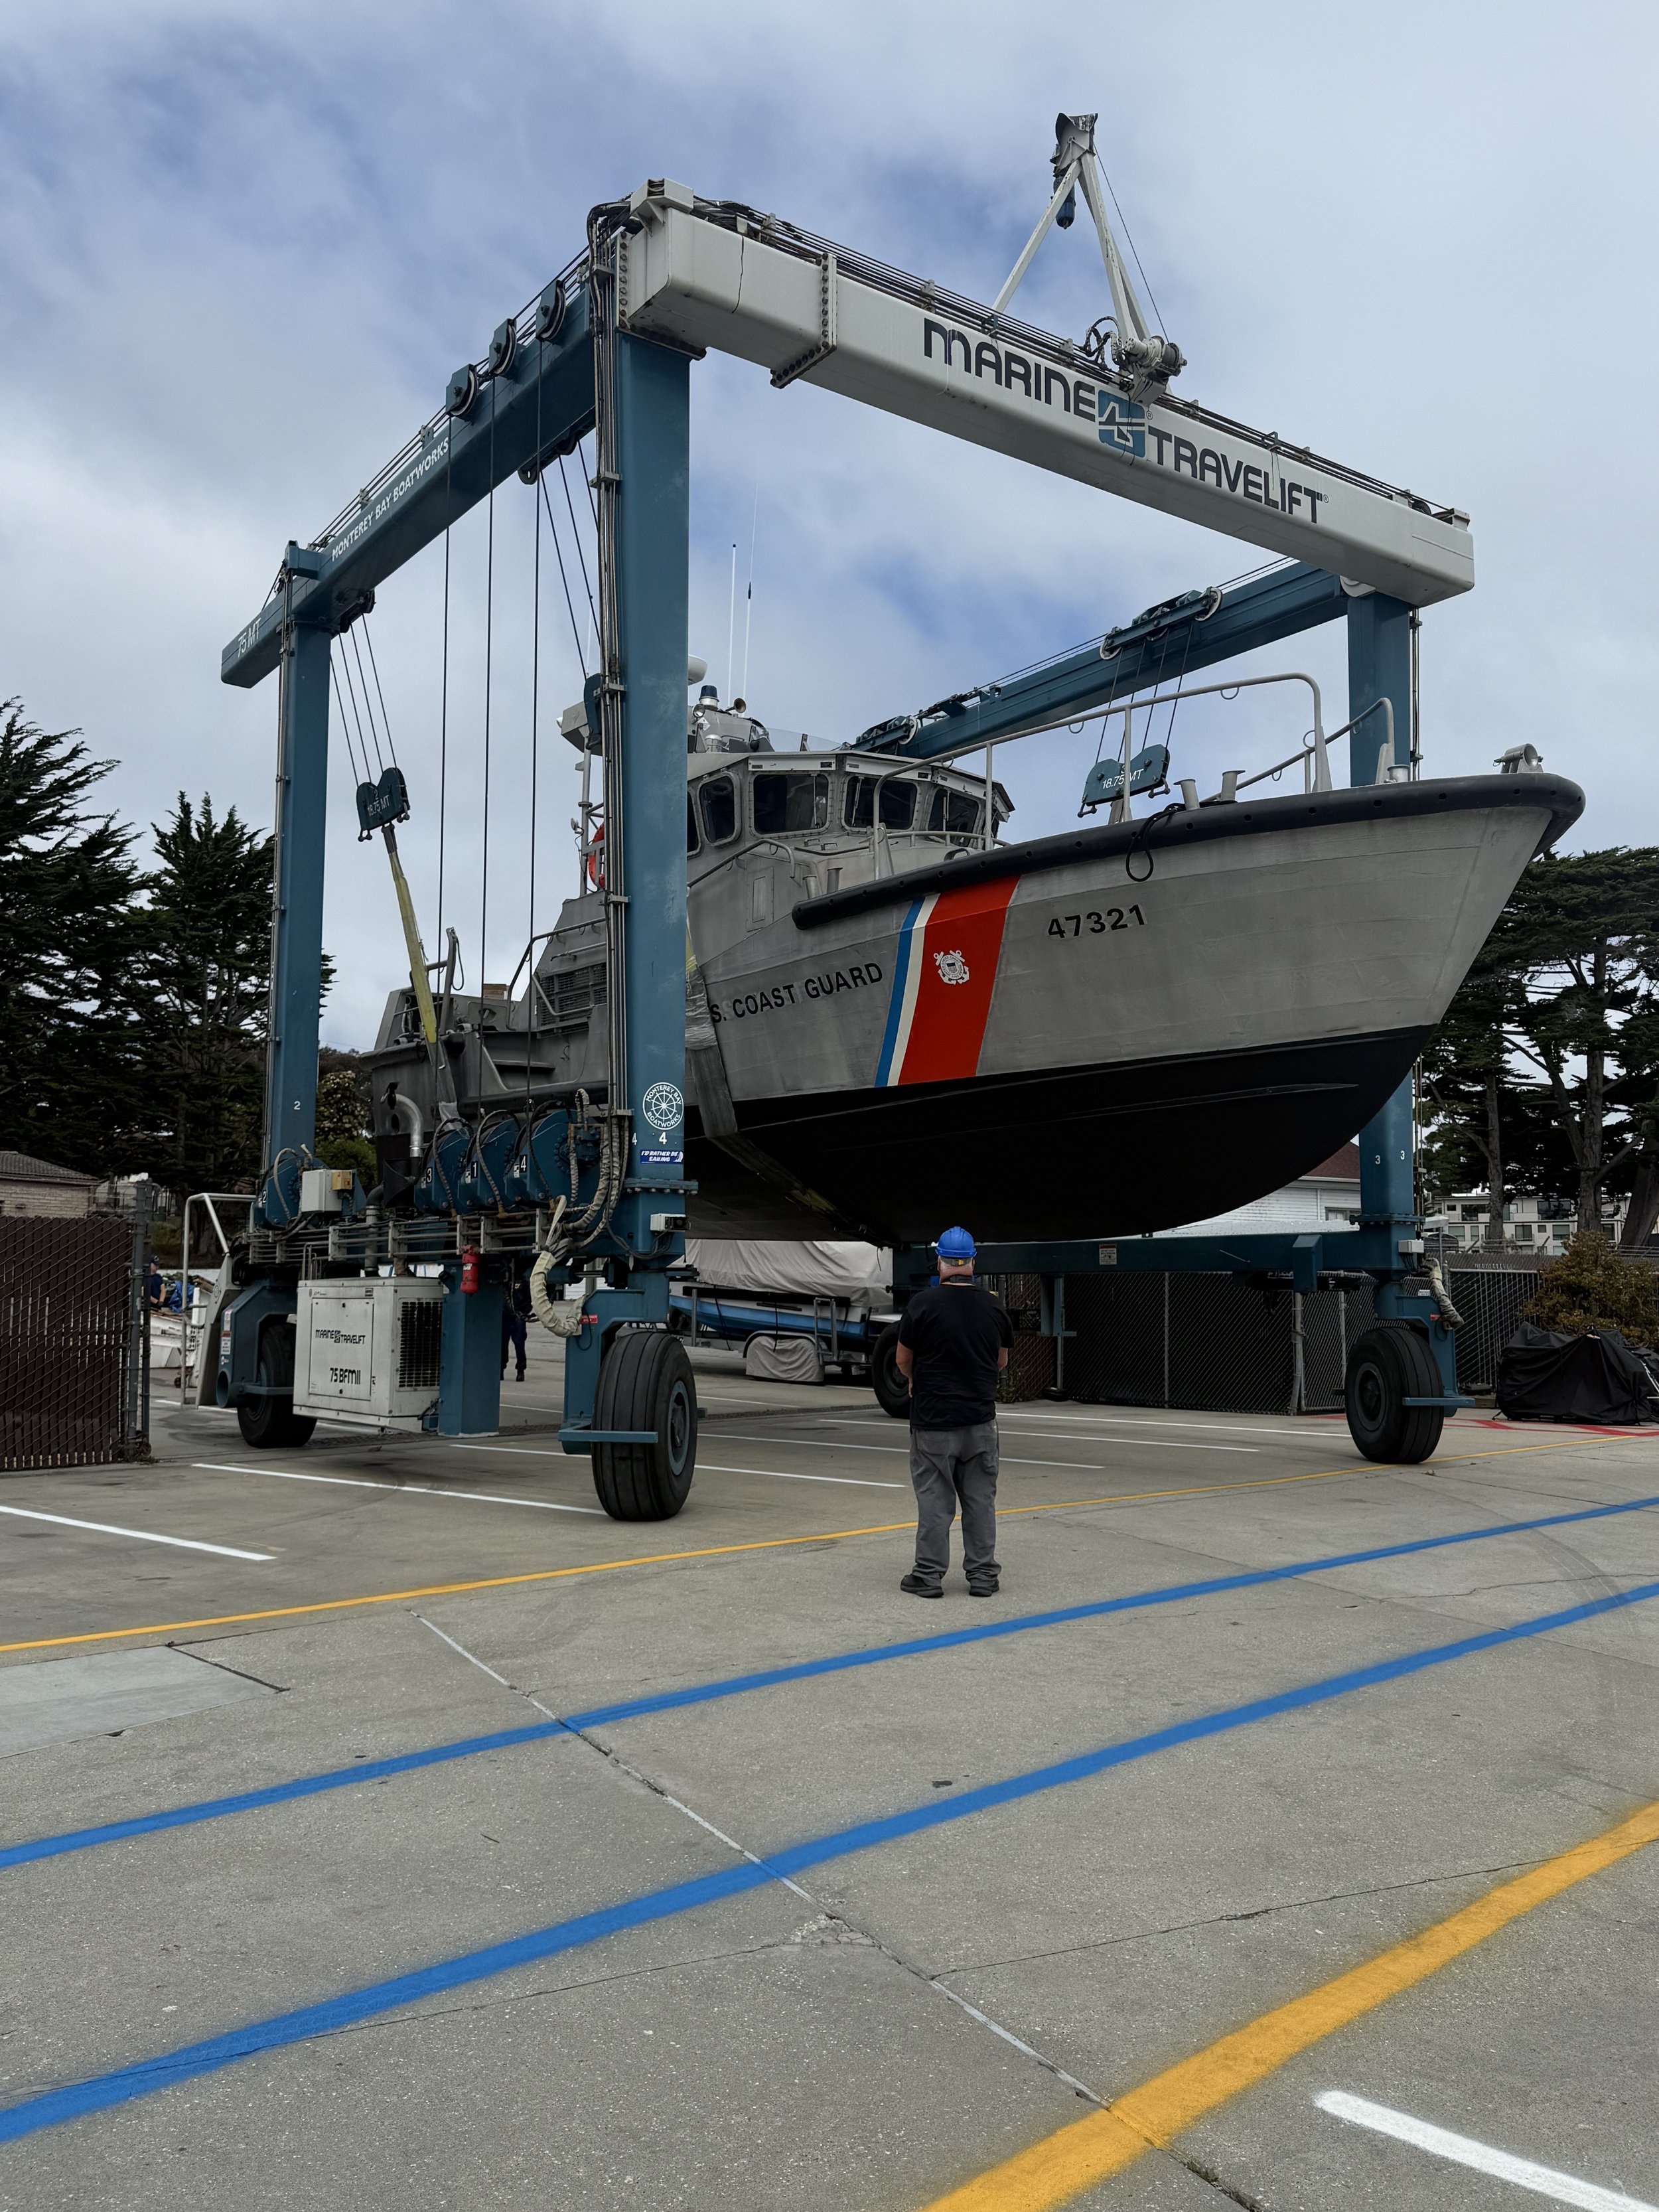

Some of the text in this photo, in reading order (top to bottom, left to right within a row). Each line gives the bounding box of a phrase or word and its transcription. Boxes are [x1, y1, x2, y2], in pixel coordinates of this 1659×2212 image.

[924, 317, 1323, 524] MARINE TRAVELIFT
[332, 437, 449, 561] MONTEREY BAY BOATWORKS
[238, 618, 261, 658] 75 MT
[1103, 774, 1124, 789] 18.75
[374, 789, 378, 800] 2
[380, 795, 389, 809] MT
[1047, 903, 1147, 940] 47321
[732, 984, 796, 1019] COAST
[805, 962, 884, 999] GUARD
[646, 1084, 675, 1102] MONTEREY
[293, 1100, 301, 1110] 2
[647, 1111, 681, 1128] BOATWORKS
[632, 1132, 638, 1145] 4
[658, 1132, 668, 1145] 4
[1375, 1155, 1381, 1165] 3
[1400, 1150, 1405, 1160] 3
[472, 1161, 477, 1177] 1
[520, 1155, 527, 1172] 4
[427, 1167, 432, 1183] 3
[261, 1191, 267, 1203] 2
[315, 1329, 366, 1345] MARINE TRAVELIFT
[330, 1367, 338, 1383] 75
